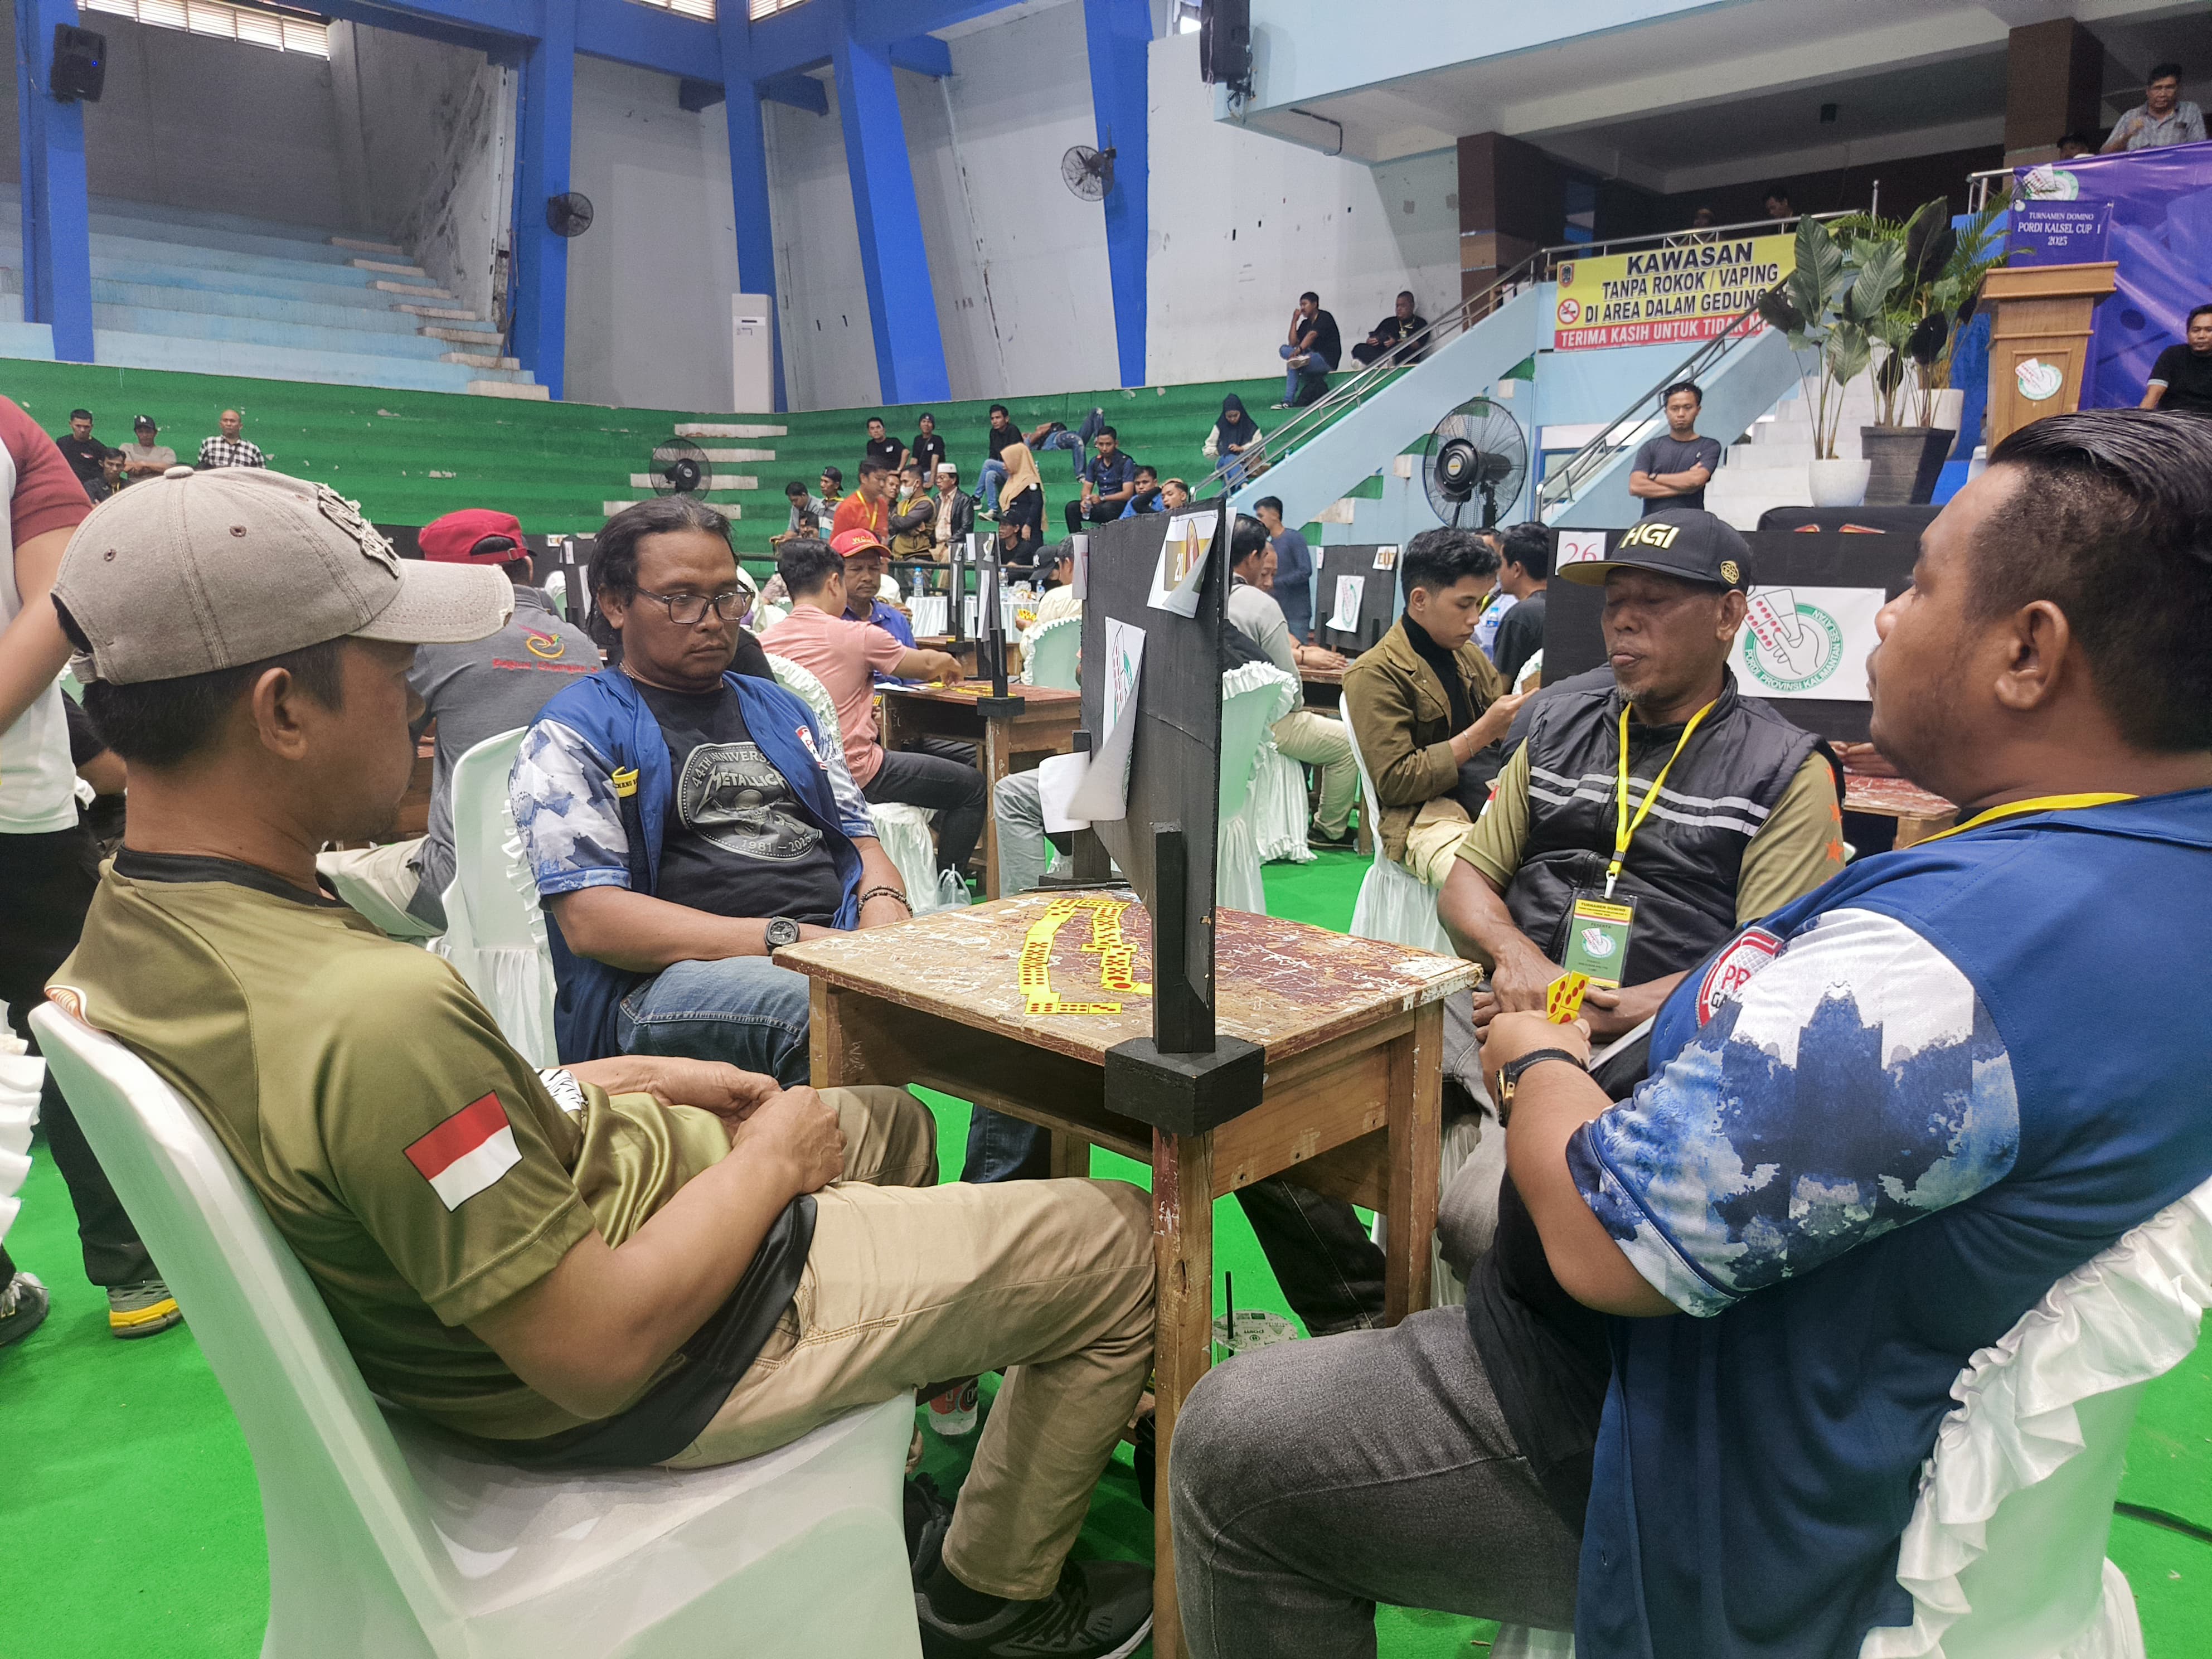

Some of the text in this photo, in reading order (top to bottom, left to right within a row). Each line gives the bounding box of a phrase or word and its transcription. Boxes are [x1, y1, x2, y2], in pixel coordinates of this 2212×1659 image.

[2017, 222, 2043, 233] PORDI
[2044, 223, 2074, 234] KALSEL
[2076, 224, 2093, 234] CUP
[2029, 212, 2065, 220] TURNAMEN
[2048, 236, 2068, 246] 2025
[1626, 242, 1753, 276] KAWASAN
[1602, 278, 1648, 300] TANPA
[1652, 271, 1706, 295] ROKOK
[1719, 263, 1778, 288] VAPING
[1585, 305, 1599, 324] DI
[1603, 301, 1641, 322] AREA
[1645, 295, 1696, 318] DALAM
[1561, 329, 1607, 348] TERIMA
[1611, 324, 1650, 343] KASIH
[1653, 320, 1699, 340] UNTUK
[1703, 316, 1744, 336] TIDK
[1619, 523, 1680, 550] HGI
[1564, 542, 1597, 564] 26
[1745, 649, 1760, 675] PORDI
[1758, 673, 1803, 691] PROVINSI
[1803, 643, 1841, 688] KALIMANTAN
[692, 750, 770, 788] 44TH ANNIVERS
[741, 840, 773, 853] 1981
[788, 833, 812, 852] 2025
